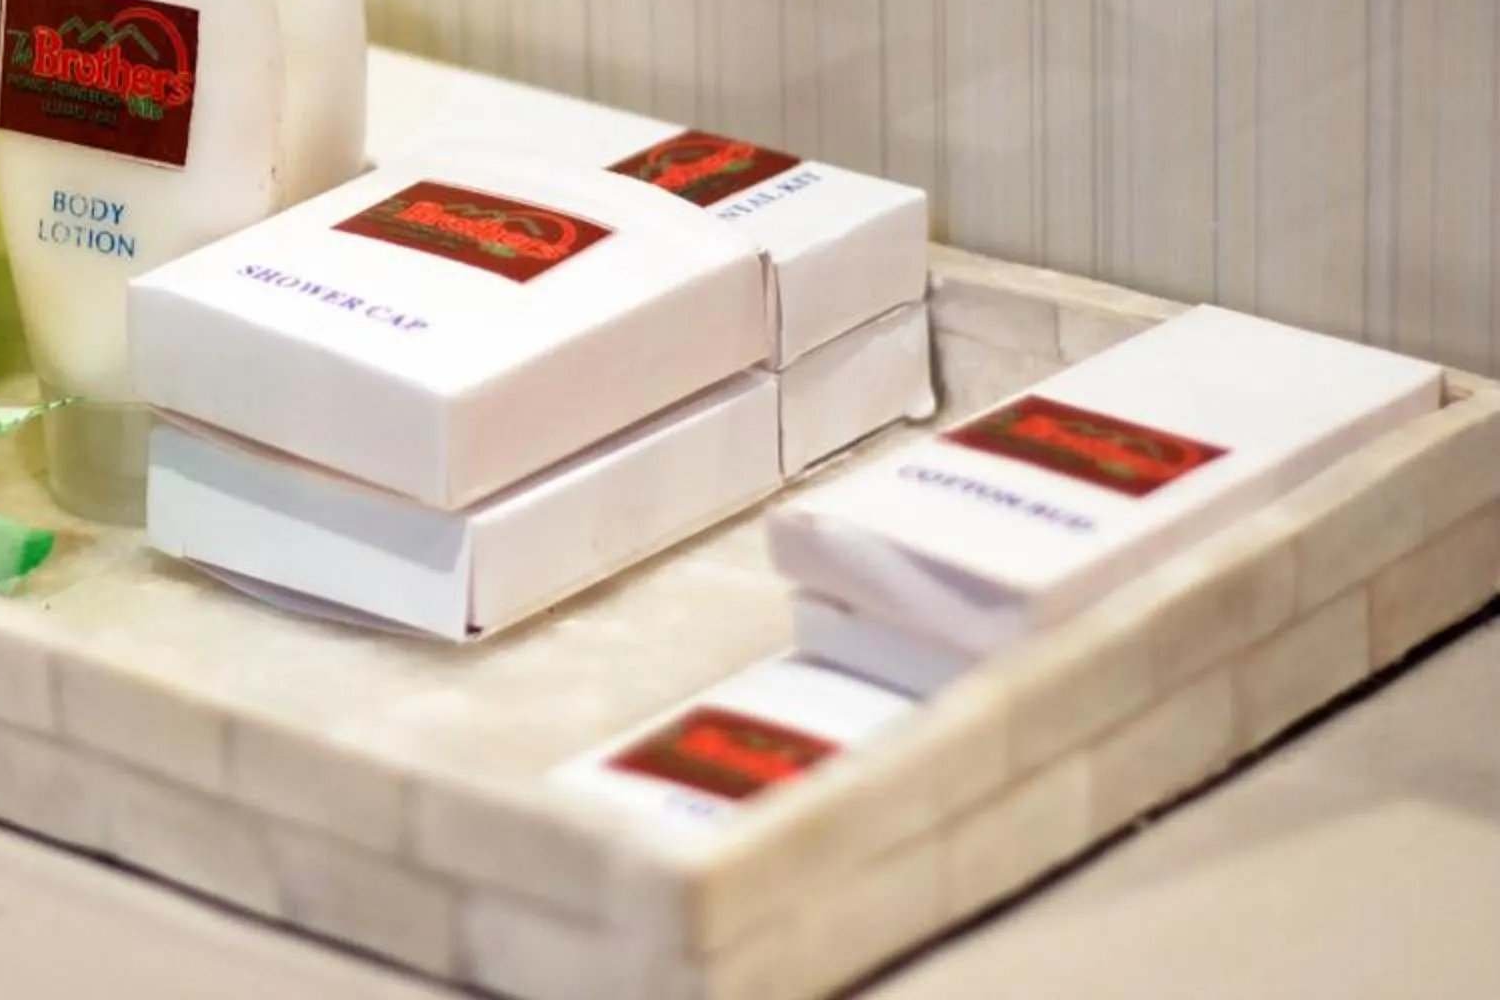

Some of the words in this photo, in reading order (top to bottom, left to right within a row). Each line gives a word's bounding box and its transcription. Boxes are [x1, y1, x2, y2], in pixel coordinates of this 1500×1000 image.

[32, 25, 192, 107] Brothers
[53, 190, 125, 225] BODY
[716, 191, 783, 220] NTAL
[38, 219, 135, 258] LOTION
[236, 264, 365, 311] SHOWER
[364, 304, 430, 331] CAP
